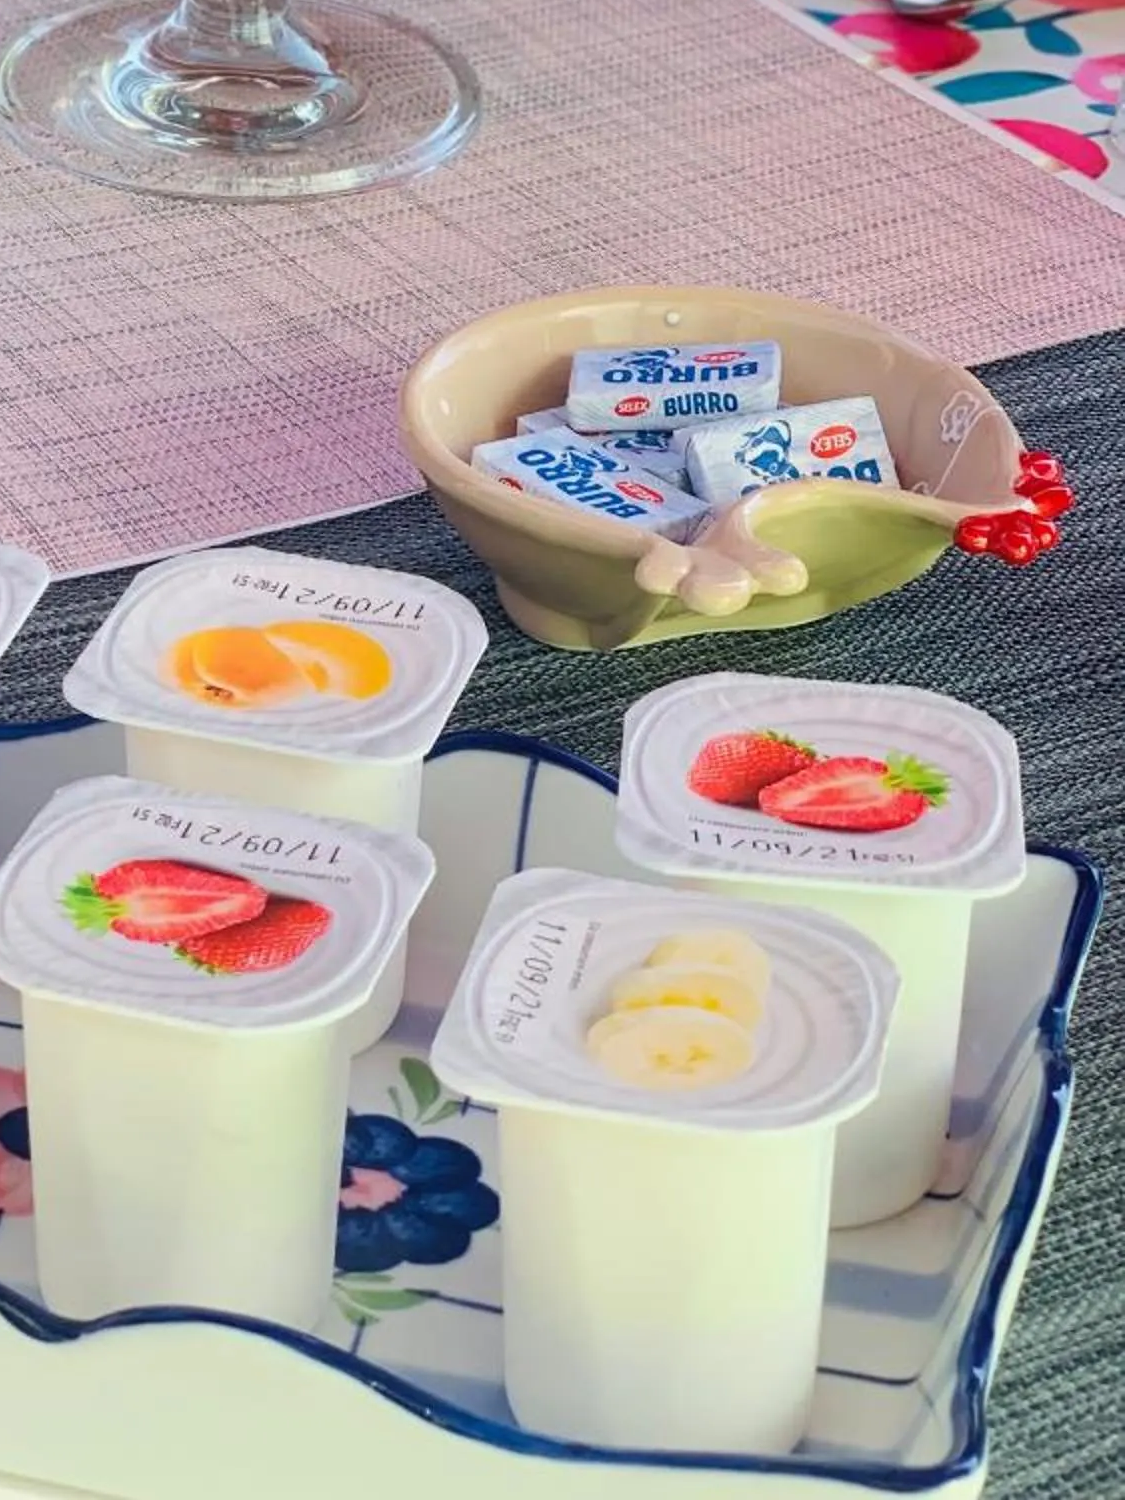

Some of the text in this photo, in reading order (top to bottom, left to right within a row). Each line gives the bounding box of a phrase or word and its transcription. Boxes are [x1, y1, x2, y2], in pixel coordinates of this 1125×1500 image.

[603, 361, 759, 384] BURRO
[663, 391, 739, 417] BURRO
[813, 431, 853, 453] SELEX
[517, 449, 648, 519] BURRO
[278, 582, 425, 620] 11/09/21
[180, 820, 341, 865] 11/09/21
[690, 828, 857, 862] 11/09/21
[506, 920, 567, 1020] 11/09/21
